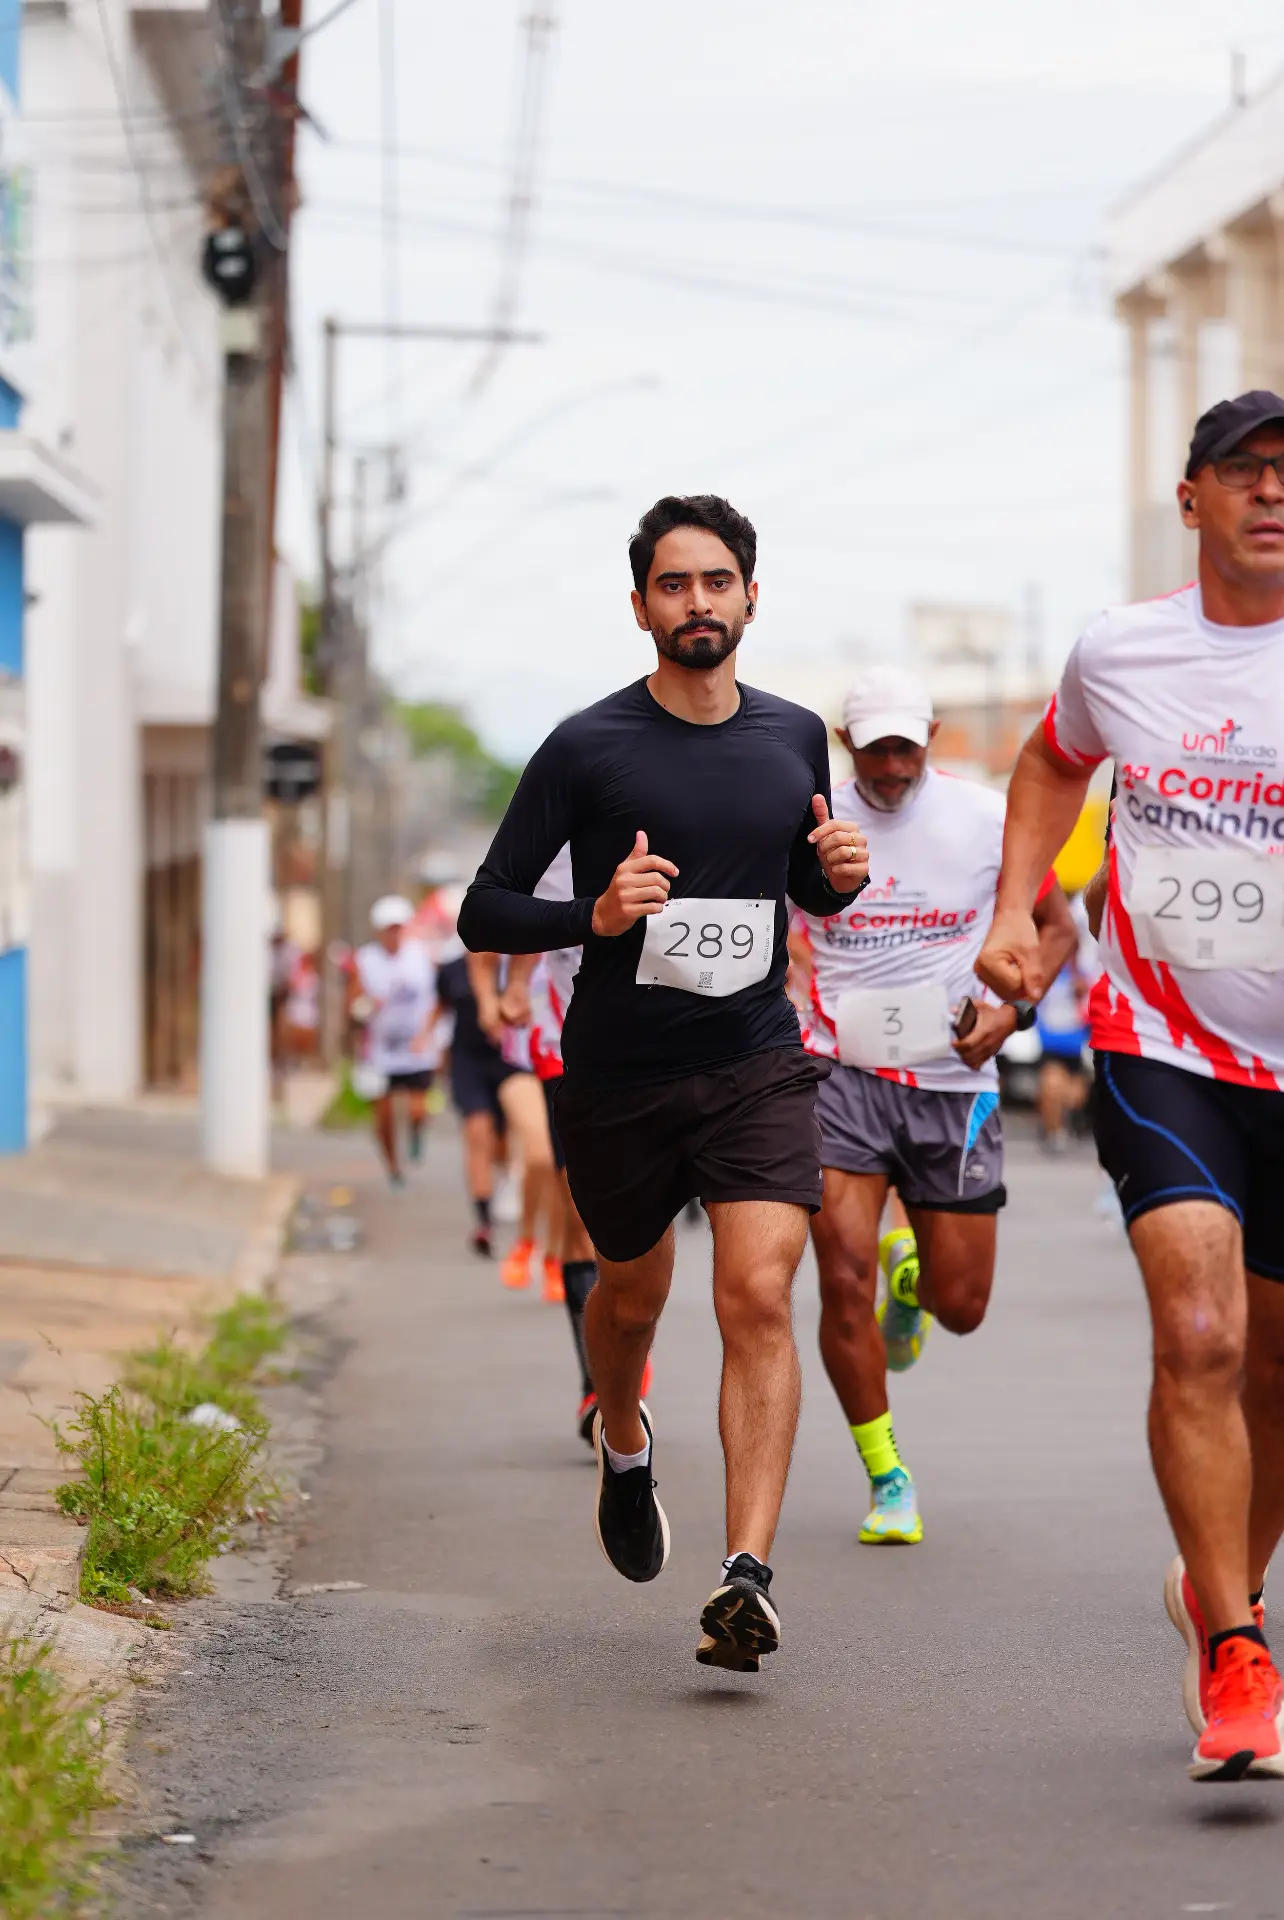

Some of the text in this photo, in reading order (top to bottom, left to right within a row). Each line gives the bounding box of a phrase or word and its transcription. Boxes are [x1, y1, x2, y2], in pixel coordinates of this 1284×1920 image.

[1154, 877, 1264, 923] 299
[848, 907, 958, 930] Corrida
[964, 908, 978, 924] e
[664, 922, 753, 959] 289
[882, 1007, 903, 1035] 3
